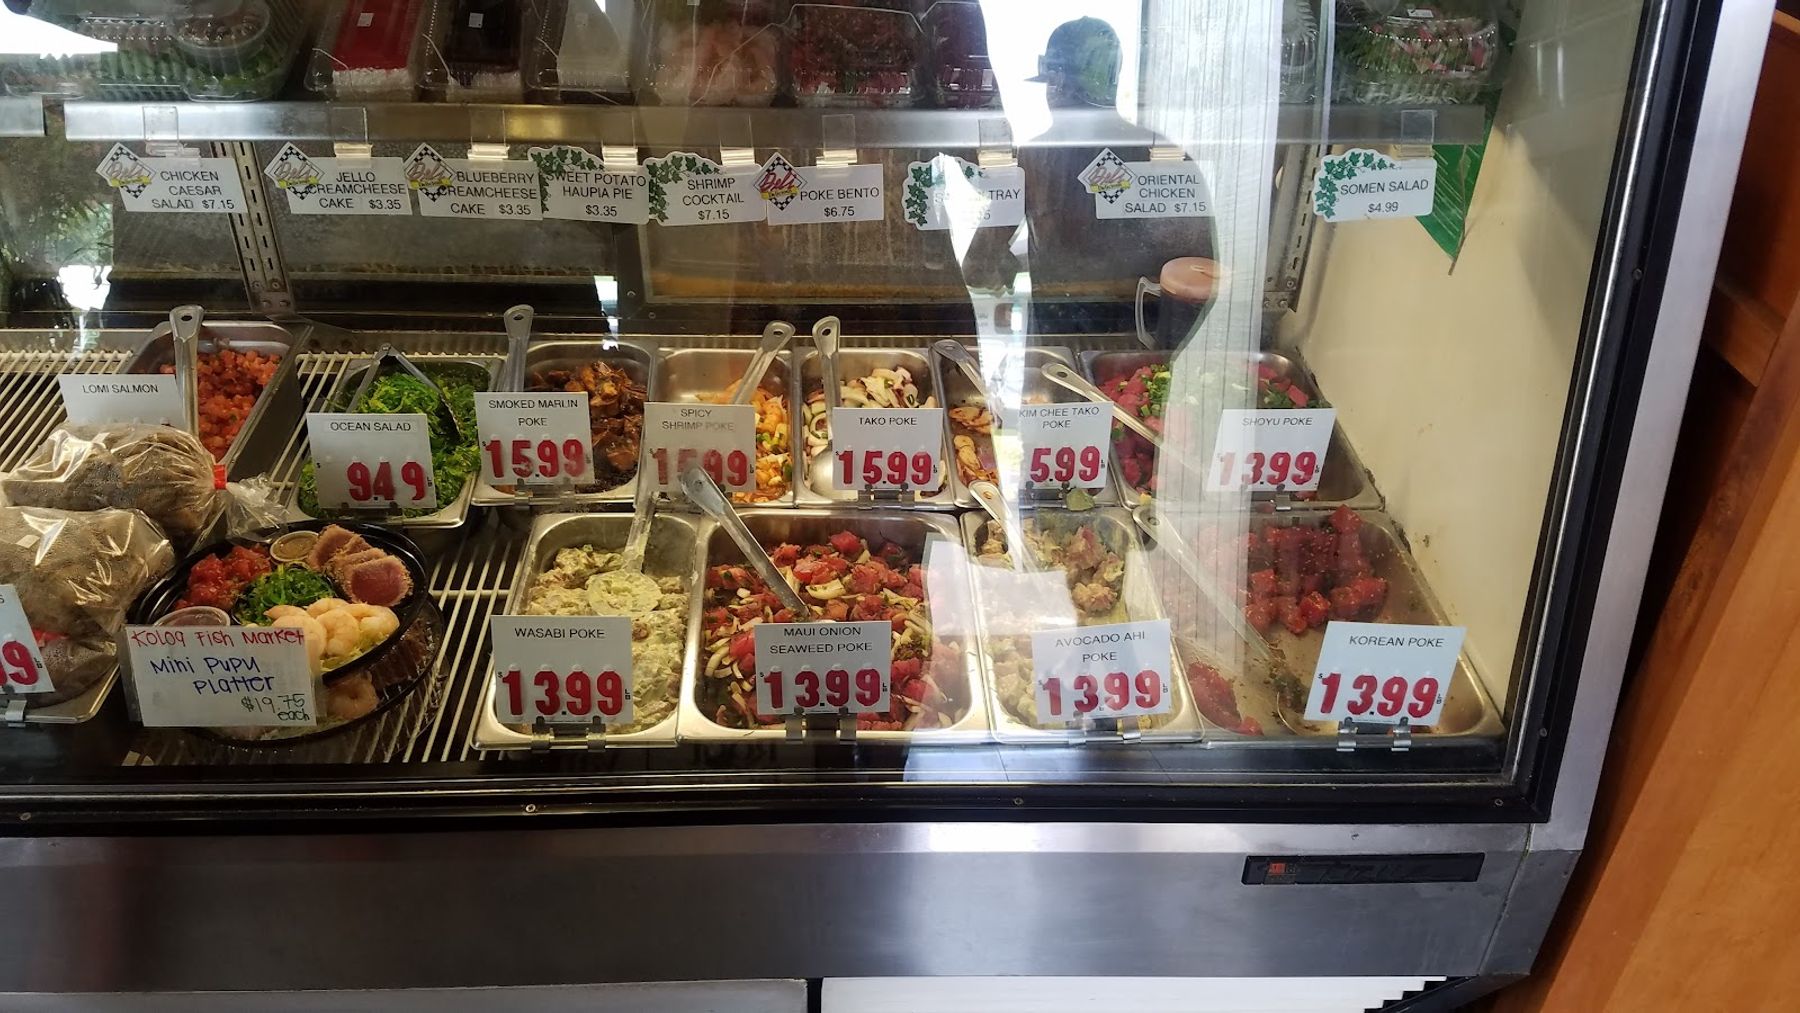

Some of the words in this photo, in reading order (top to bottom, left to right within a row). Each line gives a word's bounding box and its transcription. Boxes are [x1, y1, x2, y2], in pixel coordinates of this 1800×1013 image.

[160, 170, 219, 181] CHICKEN
[335, 171, 376, 183] JELLO
[456, 171, 534, 184] BLUEBERRY
[594, 173, 647, 187] POTATO
[1137, 174, 1200, 186] ORIENTAL
[305, 183, 406, 195] CREAMCHEESE
[687, 177, 736, 190] SHRIMP
[1340, 182, 1385, 196] SOMEN
[1388, 179, 1429, 192] SALAD
[168, 185, 222, 196] CAESAR
[437, 185, 537, 199] CREAMCHEESE
[562, 185, 609, 199] HAUPIA
[613, 187, 633, 200] PIE
[800, 189, 834, 201] POKE
[837, 186, 880, 200] BENTO
[988, 188, 1020, 201] TRAY
[1139, 187, 1196, 199] CHICKEN
[151, 198, 194, 209] SALAD
[201, 199, 235, 210] $7.15
[318, 198, 354, 209] CAKE
[368, 199, 401, 210] $3.35
[682, 193, 745, 206] COCKTAIL
[450, 203, 485, 215] CAKE
[498, 203, 531, 215] $3.35
[585, 204, 617, 217] $3.35
[823, 205, 855, 217] $6.75
[1124, 202, 1167, 213] SALAD
[1174, 202, 1207, 213] $7.15
[1367, 201, 1399, 213] $4.99
[697, 208, 730, 220] $7.15
[82, 384, 110, 394] LOMI
[111, 383, 159, 394] SALMON
[488, 399, 535, 409] SMOKED
[538, 399, 578, 409] MARLIN
[680, 408, 712, 418] SPICY
[1018, 409, 1037, 417] KIM
[1040, 408, 1069, 418] CHEE
[1072, 406, 1100, 416] TAKO
[329, 421, 371, 432] OCEAN
[373, 421, 412, 432] SALAD
[518, 417, 548, 427] POKE
[661, 420, 702, 430] SHRIMP
[705, 422, 735, 431] POKE
[859, 417, 886, 426] TAKO
[889, 417, 918, 426] POKE
[1042, 420, 1071, 429] POKE
[1242, 417, 1281, 427] SHOYU
[1283, 417, 1314, 426] POKE
[514, 627, 566, 639] WASABI
[569, 628, 606, 639] POKE
[783, 627, 816, 637] MAUI
[819, 626, 862, 637] ONION
[1055, 633, 1121, 648] AVOCADO
[1123, 631, 1146, 642] AHI
[1349, 635, 1405, 647] KOREAN
[1408, 637, 1445, 648] POKE
[769, 643, 834, 655] SEAWEED
[837, 642, 873, 652] POKE
[1082, 651, 1118, 663] POKE
[150, 656, 195, 674] Mini
[277, 710, 311, 722] each
